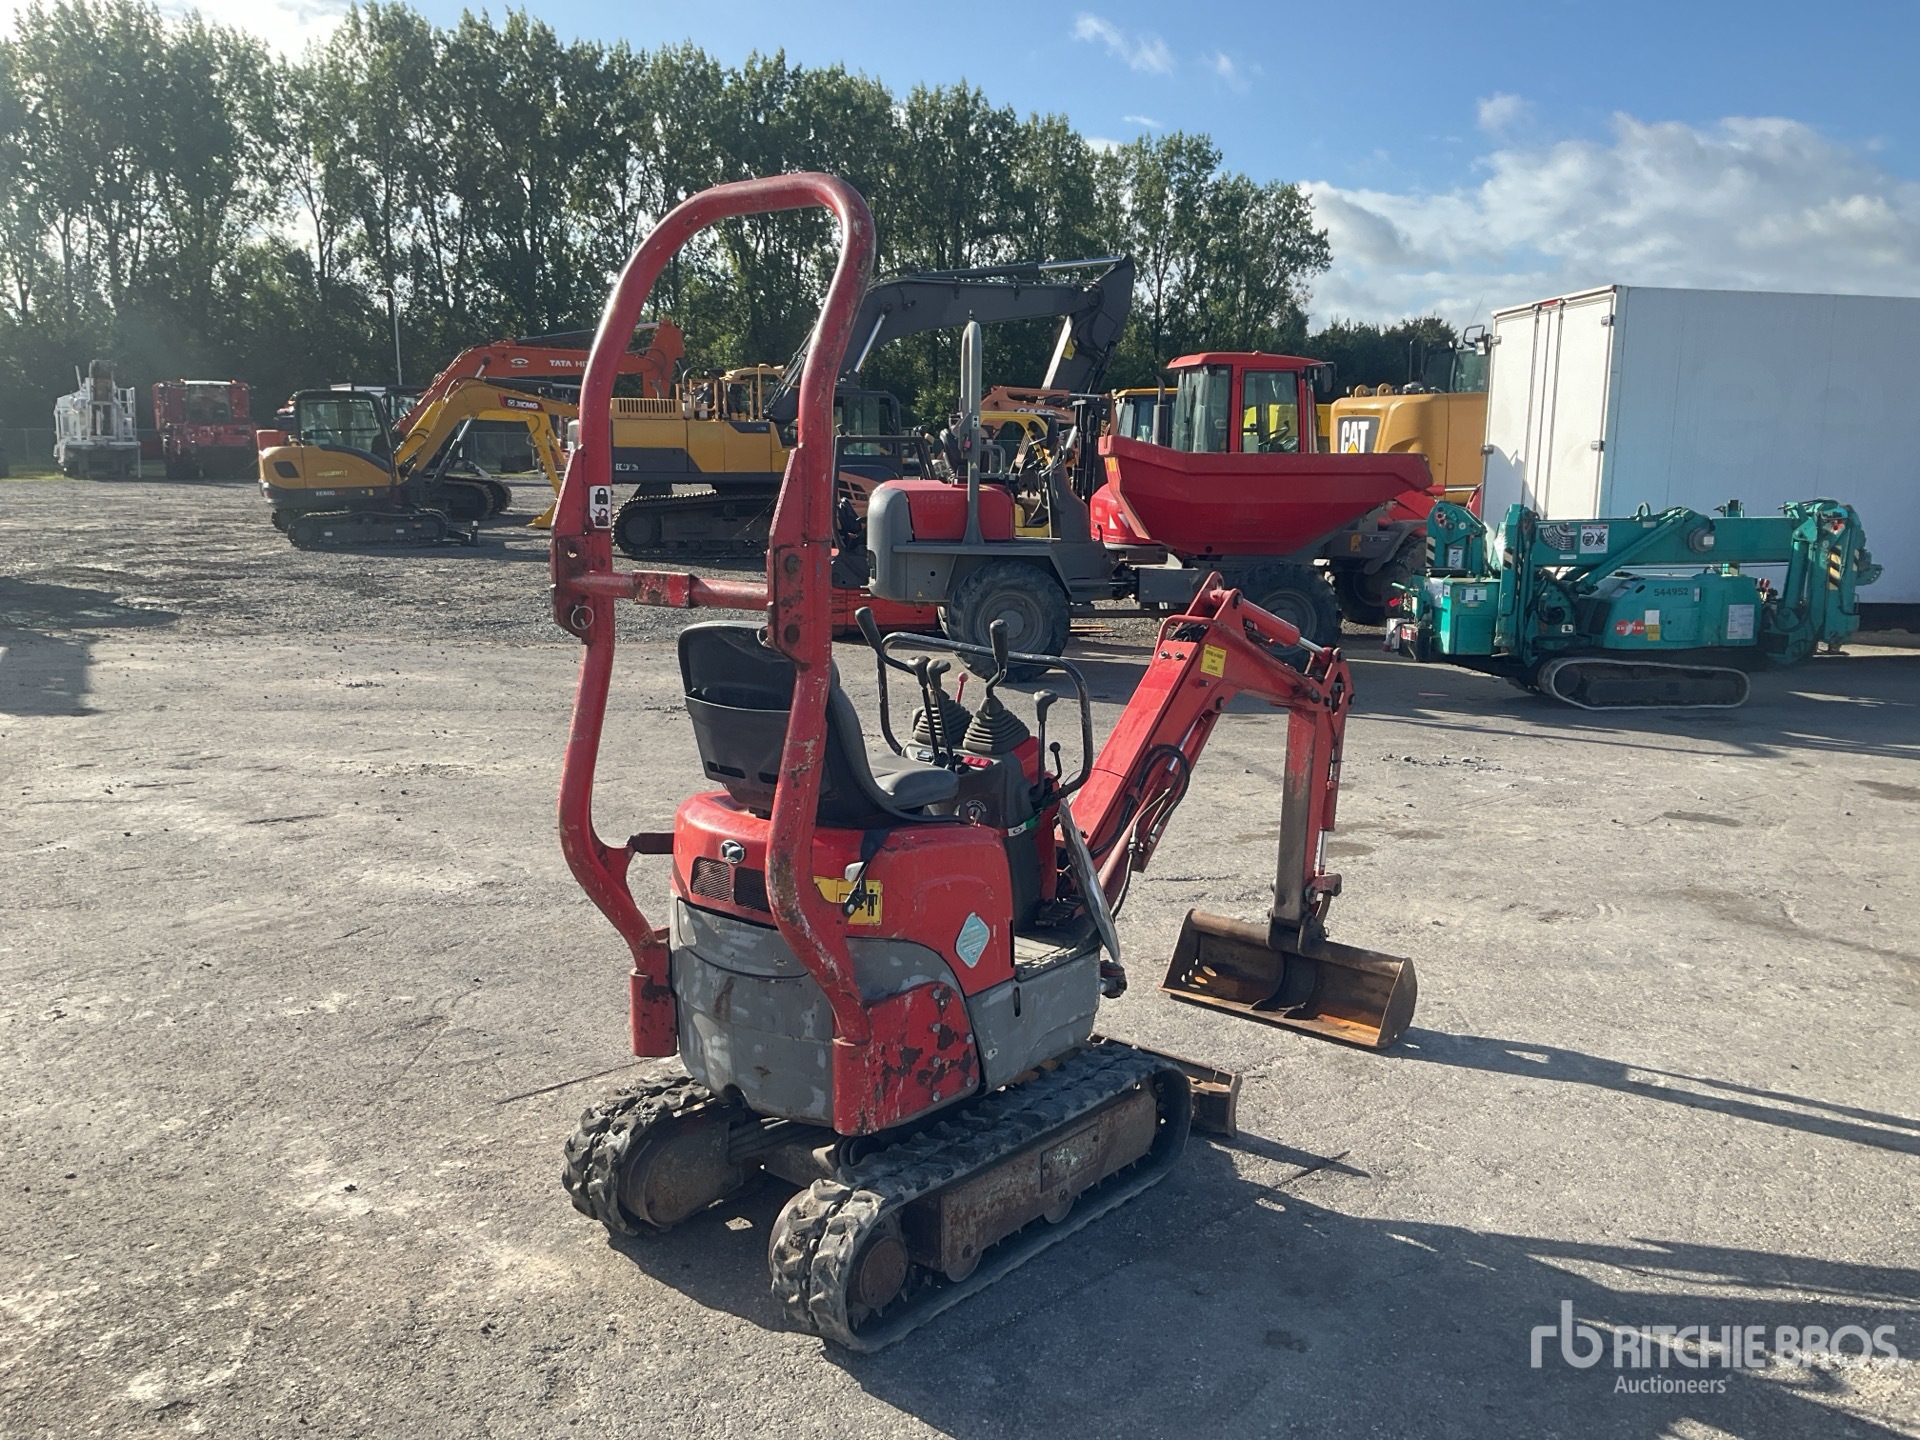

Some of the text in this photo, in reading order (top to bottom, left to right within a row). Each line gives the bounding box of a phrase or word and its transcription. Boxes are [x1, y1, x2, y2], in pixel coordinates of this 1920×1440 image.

[549, 359, 572, 367] TATA
[1340, 420, 1370, 454] CAT
[1653, 587, 1689, 597] 544952
